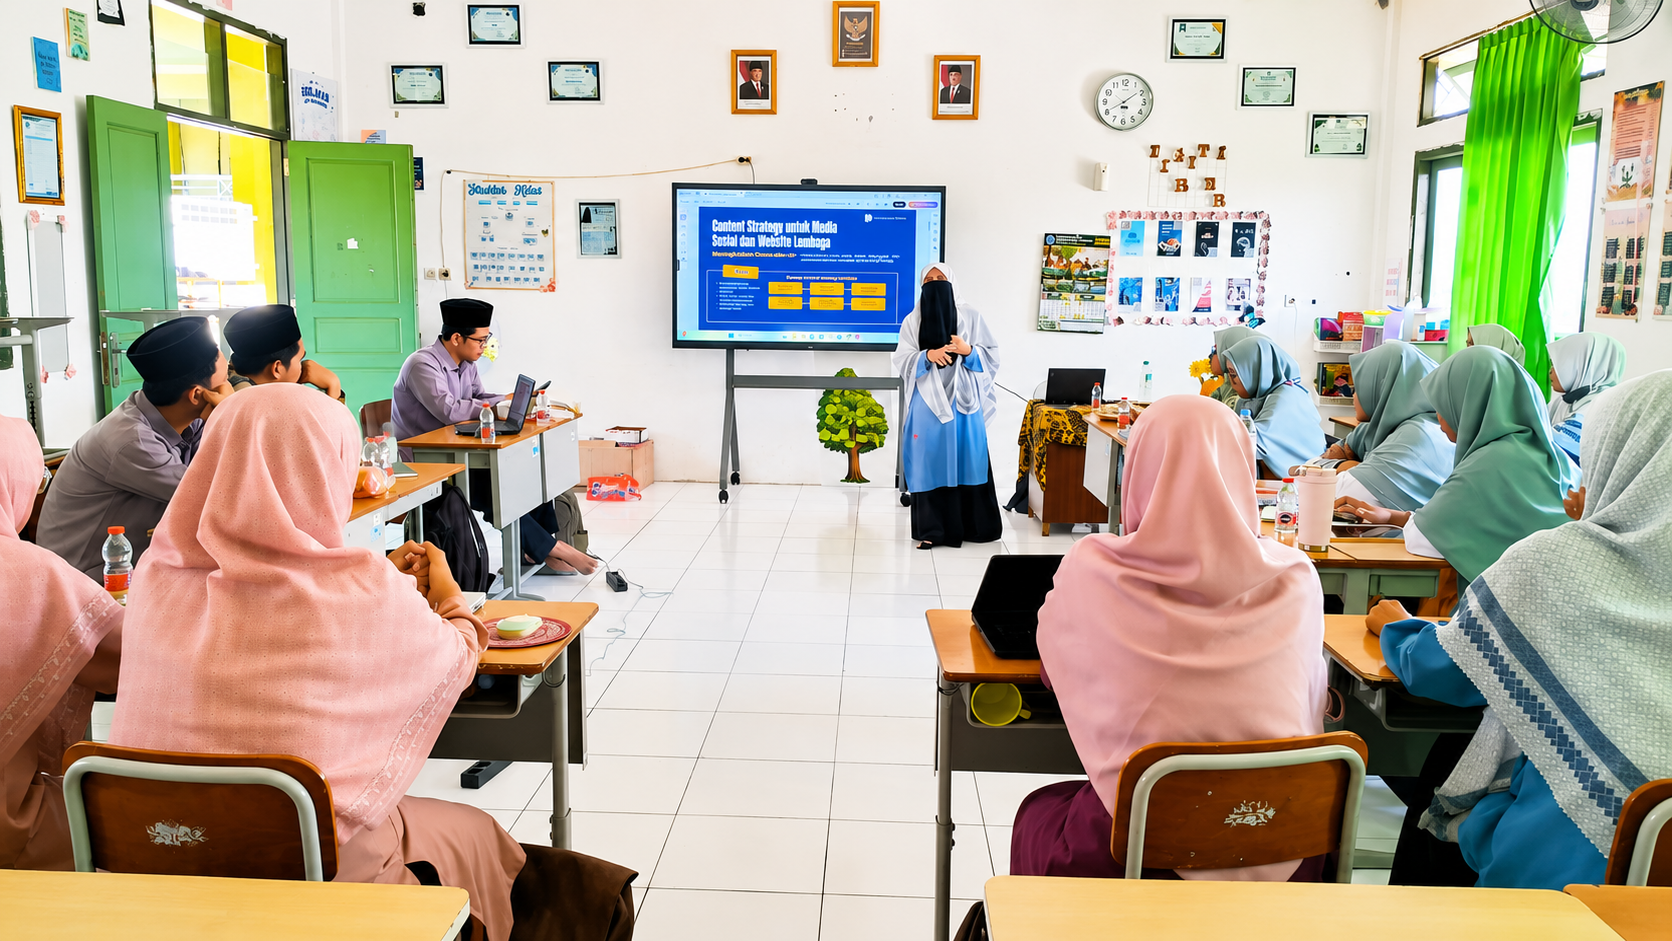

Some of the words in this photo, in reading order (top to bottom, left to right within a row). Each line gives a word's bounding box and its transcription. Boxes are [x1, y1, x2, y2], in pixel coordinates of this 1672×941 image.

[1121, 79, 1130, 87] 12
[1139, 89, 1145, 97] 2
[1102, 98, 1108, 106] 9
[1141, 98, 1147, 107] 3
[1104, 108, 1110, 116] 8
[1137, 108, 1143, 116] 4
[1112, 115, 1117, 123] 7
[1120, 118, 1126, 126] 6
[1130, 115, 1136, 123] 5
[712, 218, 746, 233] Content
[746, 219, 784, 236] Strategy
[785, 220, 811, 234] untuk
[811, 220, 838, 234] Media
[739, 234, 756, 247] dan
[757, 234, 792, 248] Website
[793, 235, 831, 251] Lembaga
